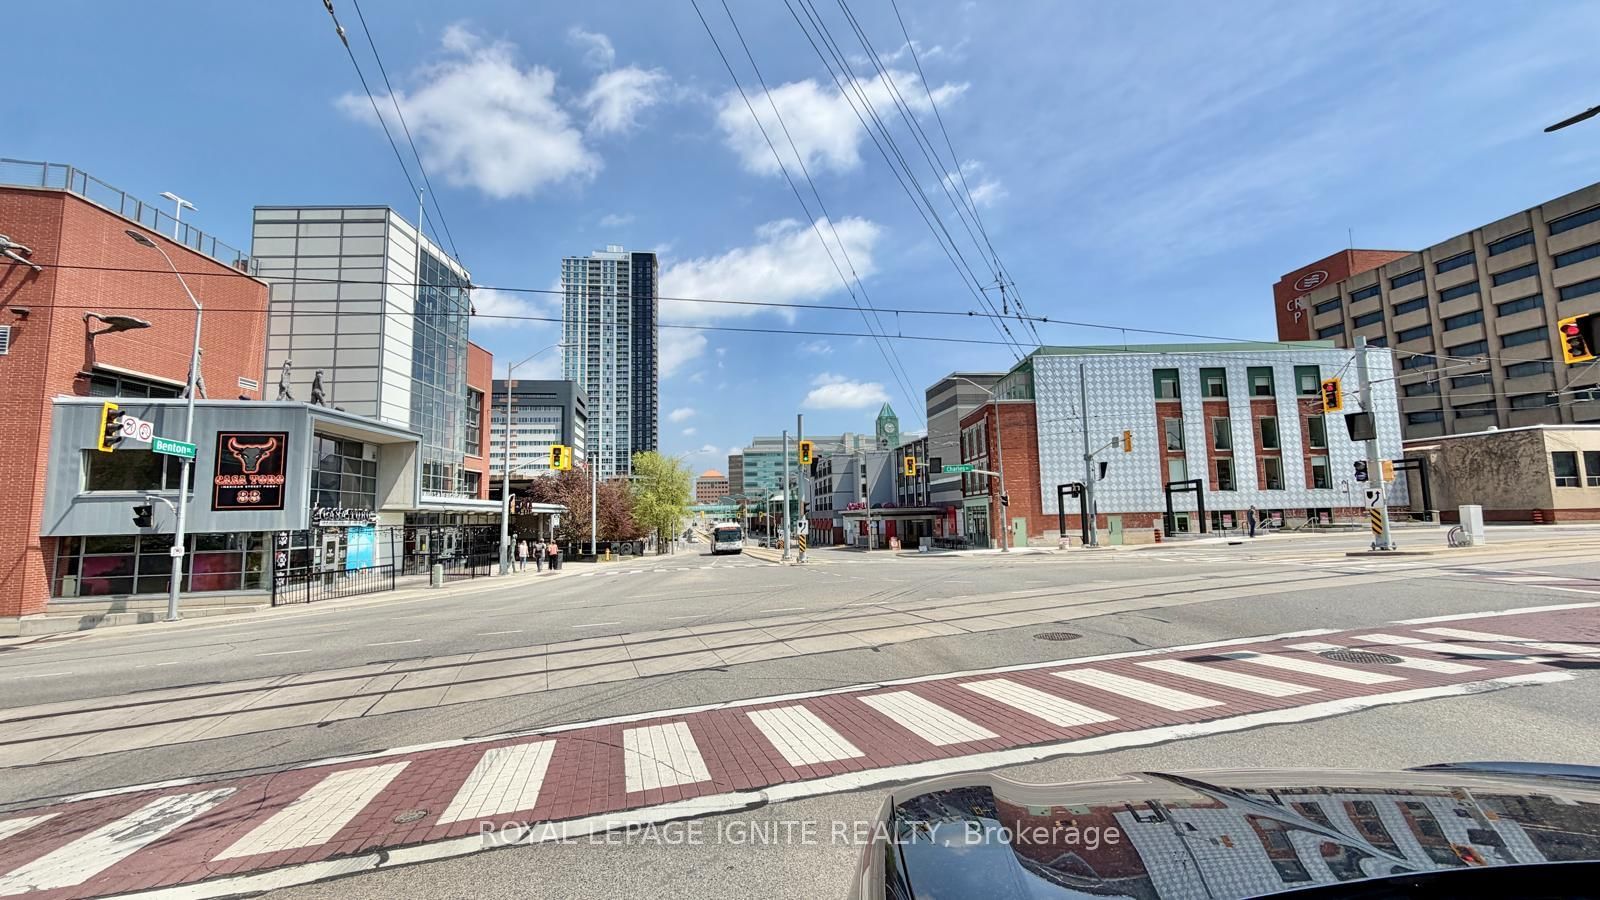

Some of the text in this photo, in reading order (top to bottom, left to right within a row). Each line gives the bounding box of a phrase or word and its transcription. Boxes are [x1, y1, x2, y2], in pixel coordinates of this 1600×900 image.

[156, 440, 187, 454] Benton
[215, 474, 284, 485] CASA TORO
